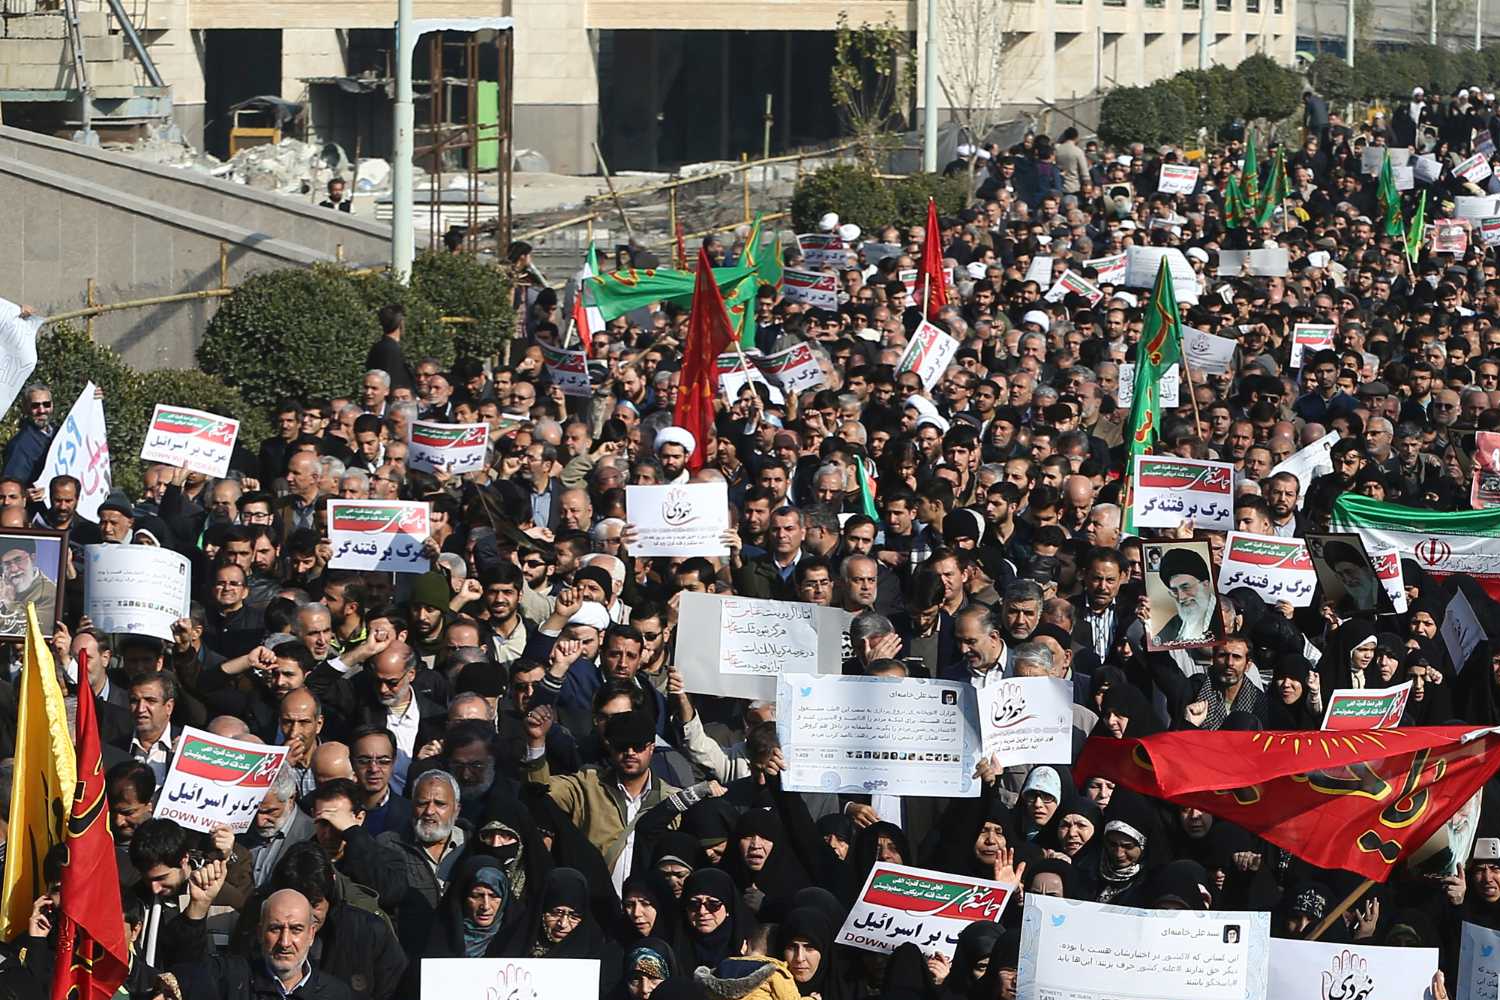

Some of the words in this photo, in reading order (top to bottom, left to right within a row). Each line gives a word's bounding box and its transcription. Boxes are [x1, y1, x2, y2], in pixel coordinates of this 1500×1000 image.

[1200, 502, 1230, 520] مرگ
[1286, 580, 1312, 596] مرگ
[168, 782, 229, 809] اسرائیل
[160, 808, 198, 825] DOWN
[853, 911, 923, 938] اسرائیل
[844, 933, 889, 950] DOWN
[922, 930, 942, 946] بر
